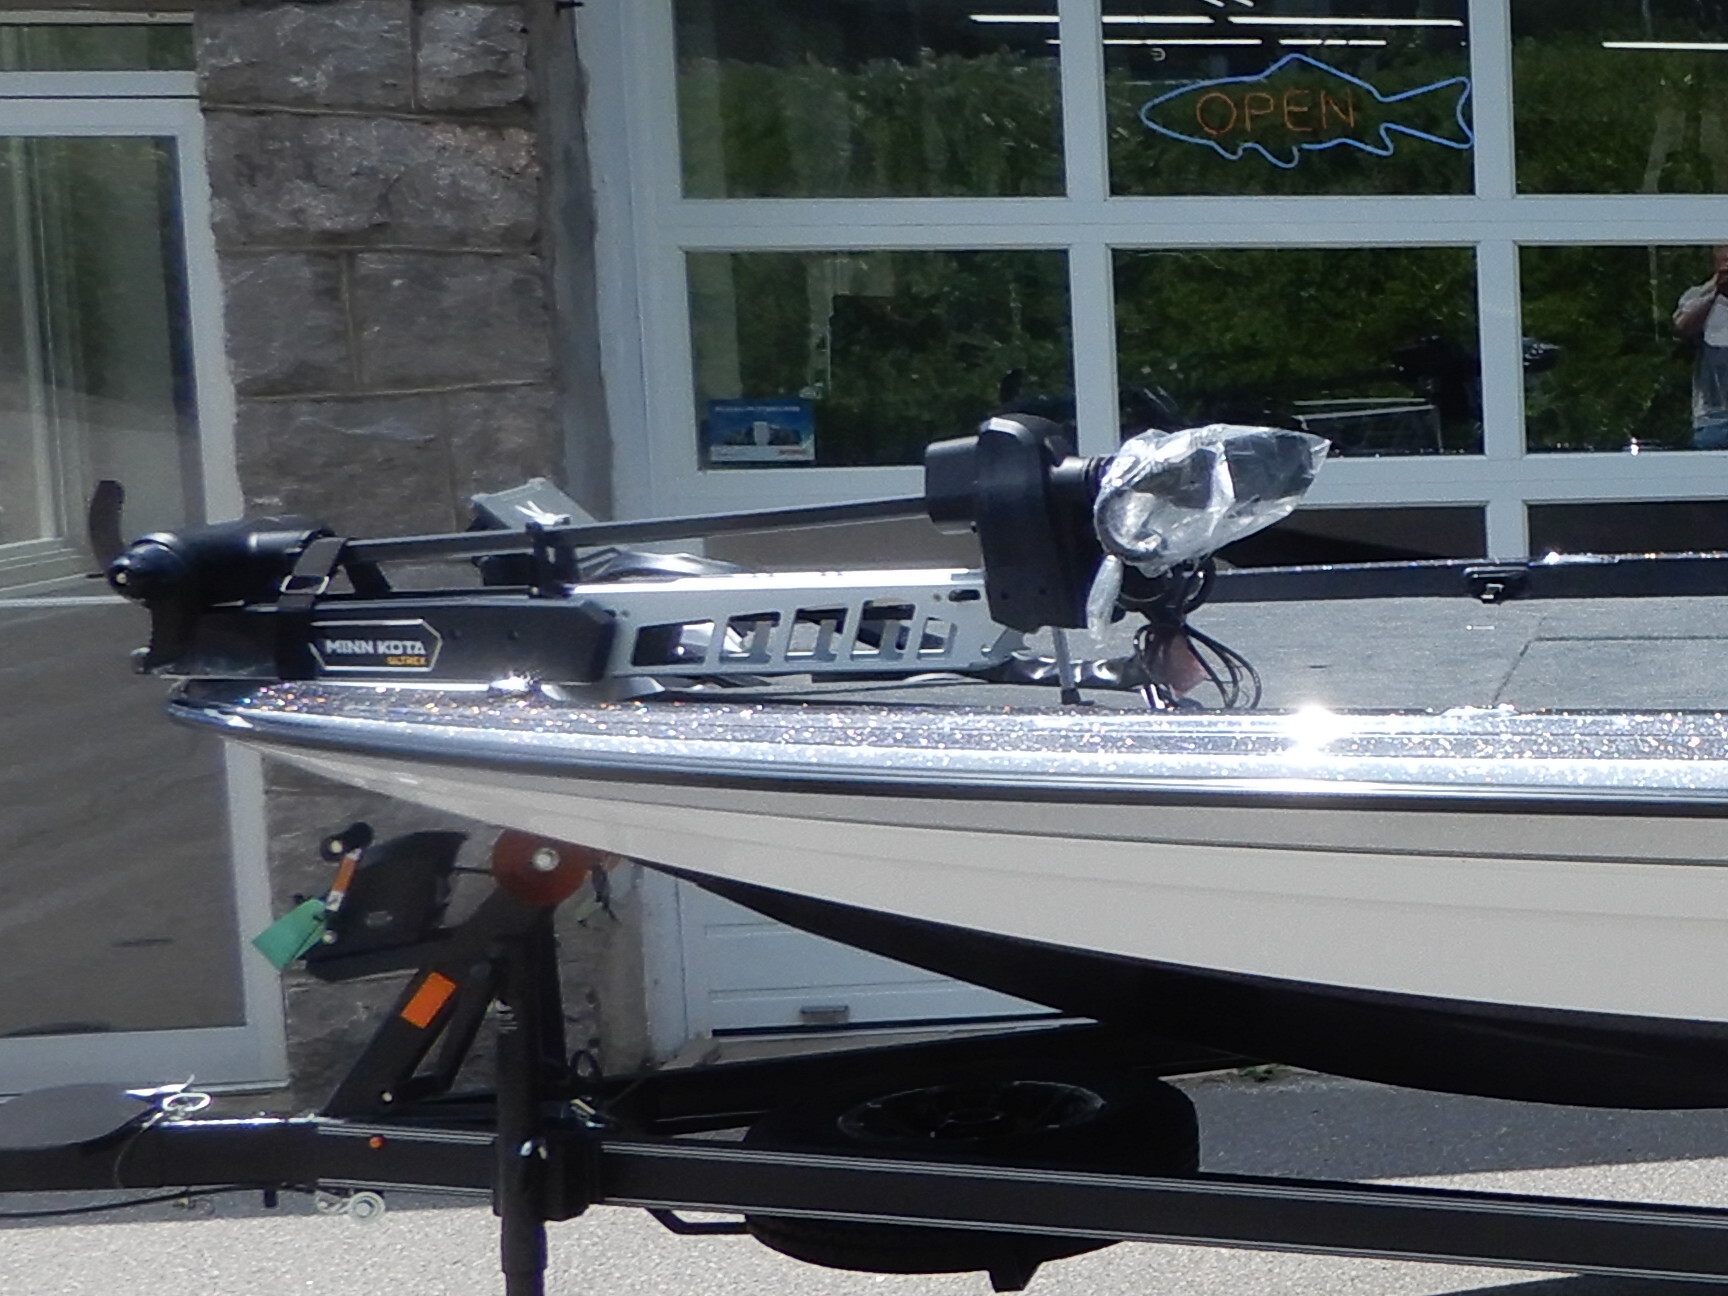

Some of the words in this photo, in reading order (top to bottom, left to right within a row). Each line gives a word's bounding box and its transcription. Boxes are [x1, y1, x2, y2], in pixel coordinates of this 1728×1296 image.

[1195, 88, 1358, 136] OPEN
[324, 638, 375, 655] MINN
[376, 639, 427, 655] KOTA
